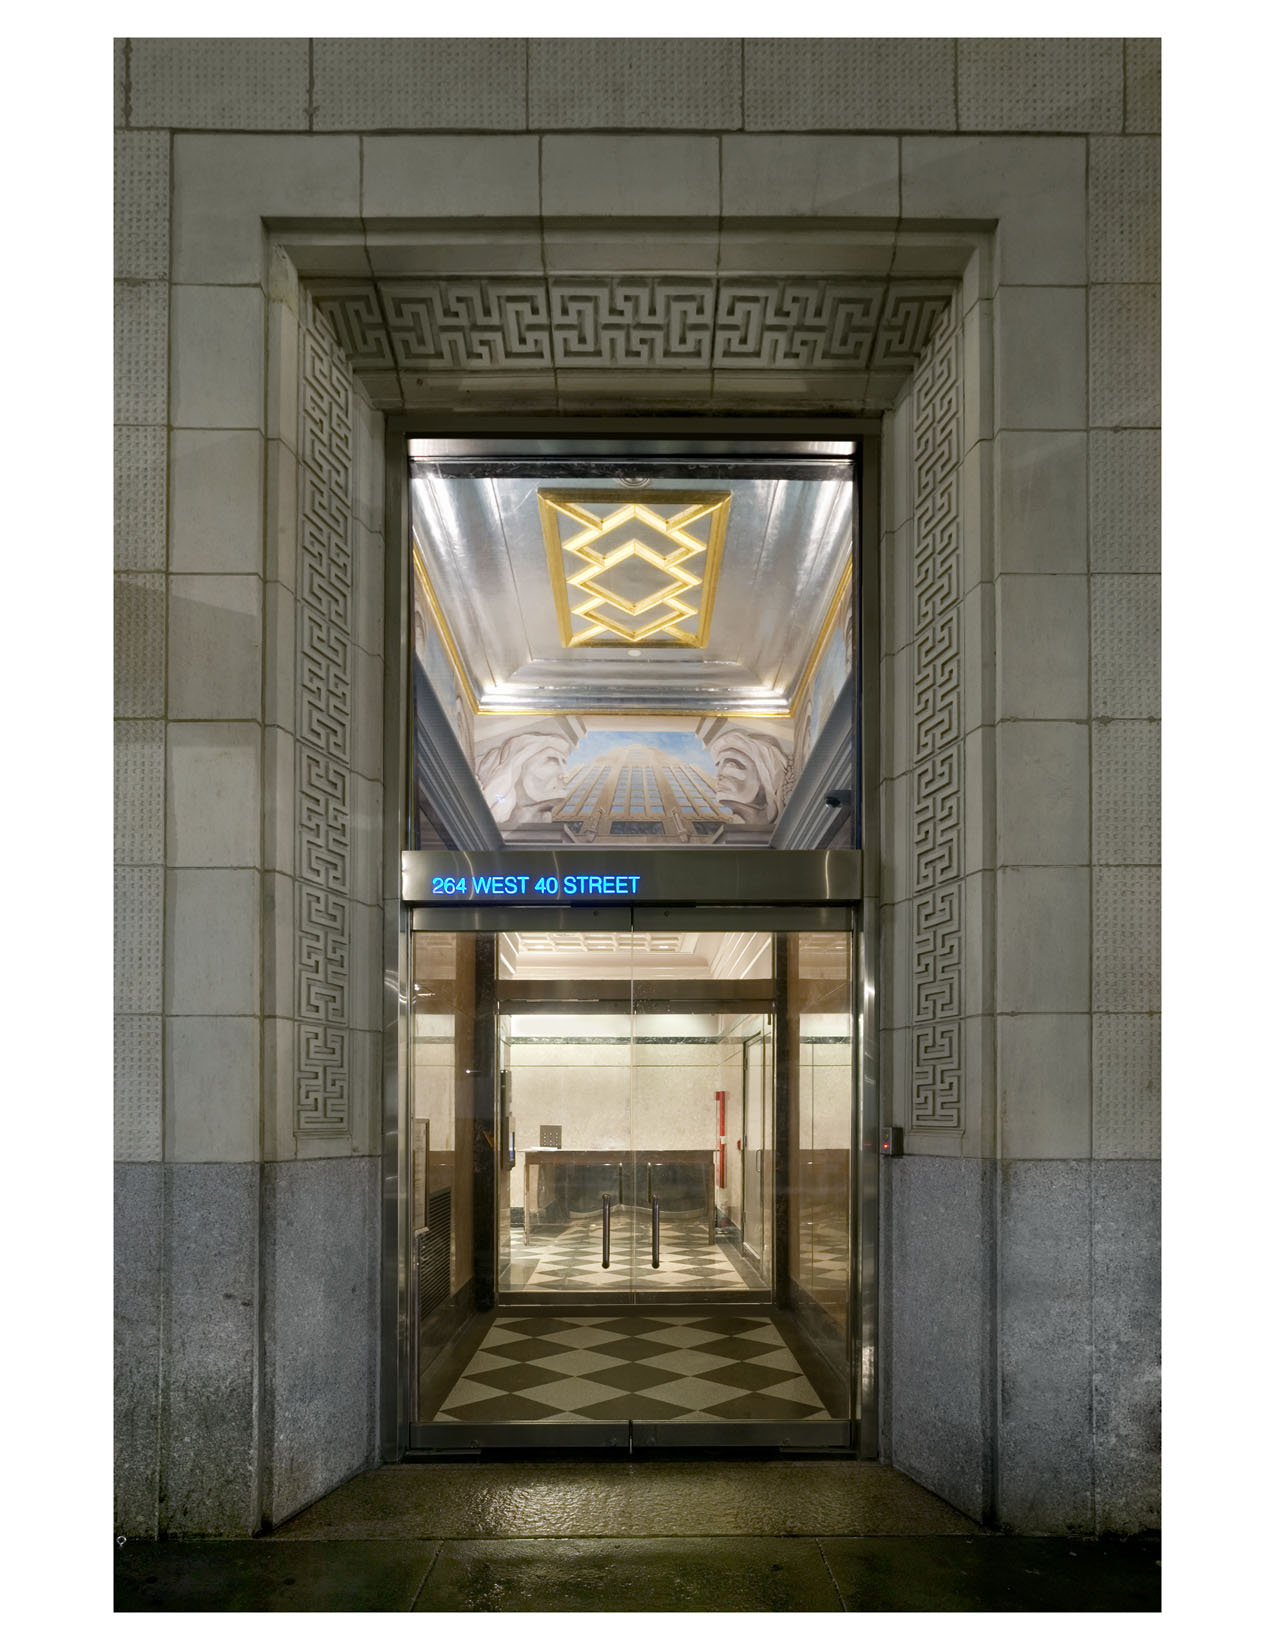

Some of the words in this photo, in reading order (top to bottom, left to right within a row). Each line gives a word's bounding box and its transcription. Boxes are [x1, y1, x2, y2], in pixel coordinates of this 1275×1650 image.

[432, 877, 467, 894] 264
[472, 876, 530, 894] WEST
[534, 877, 559, 894] 40
[563, 876, 640, 894] STREET
